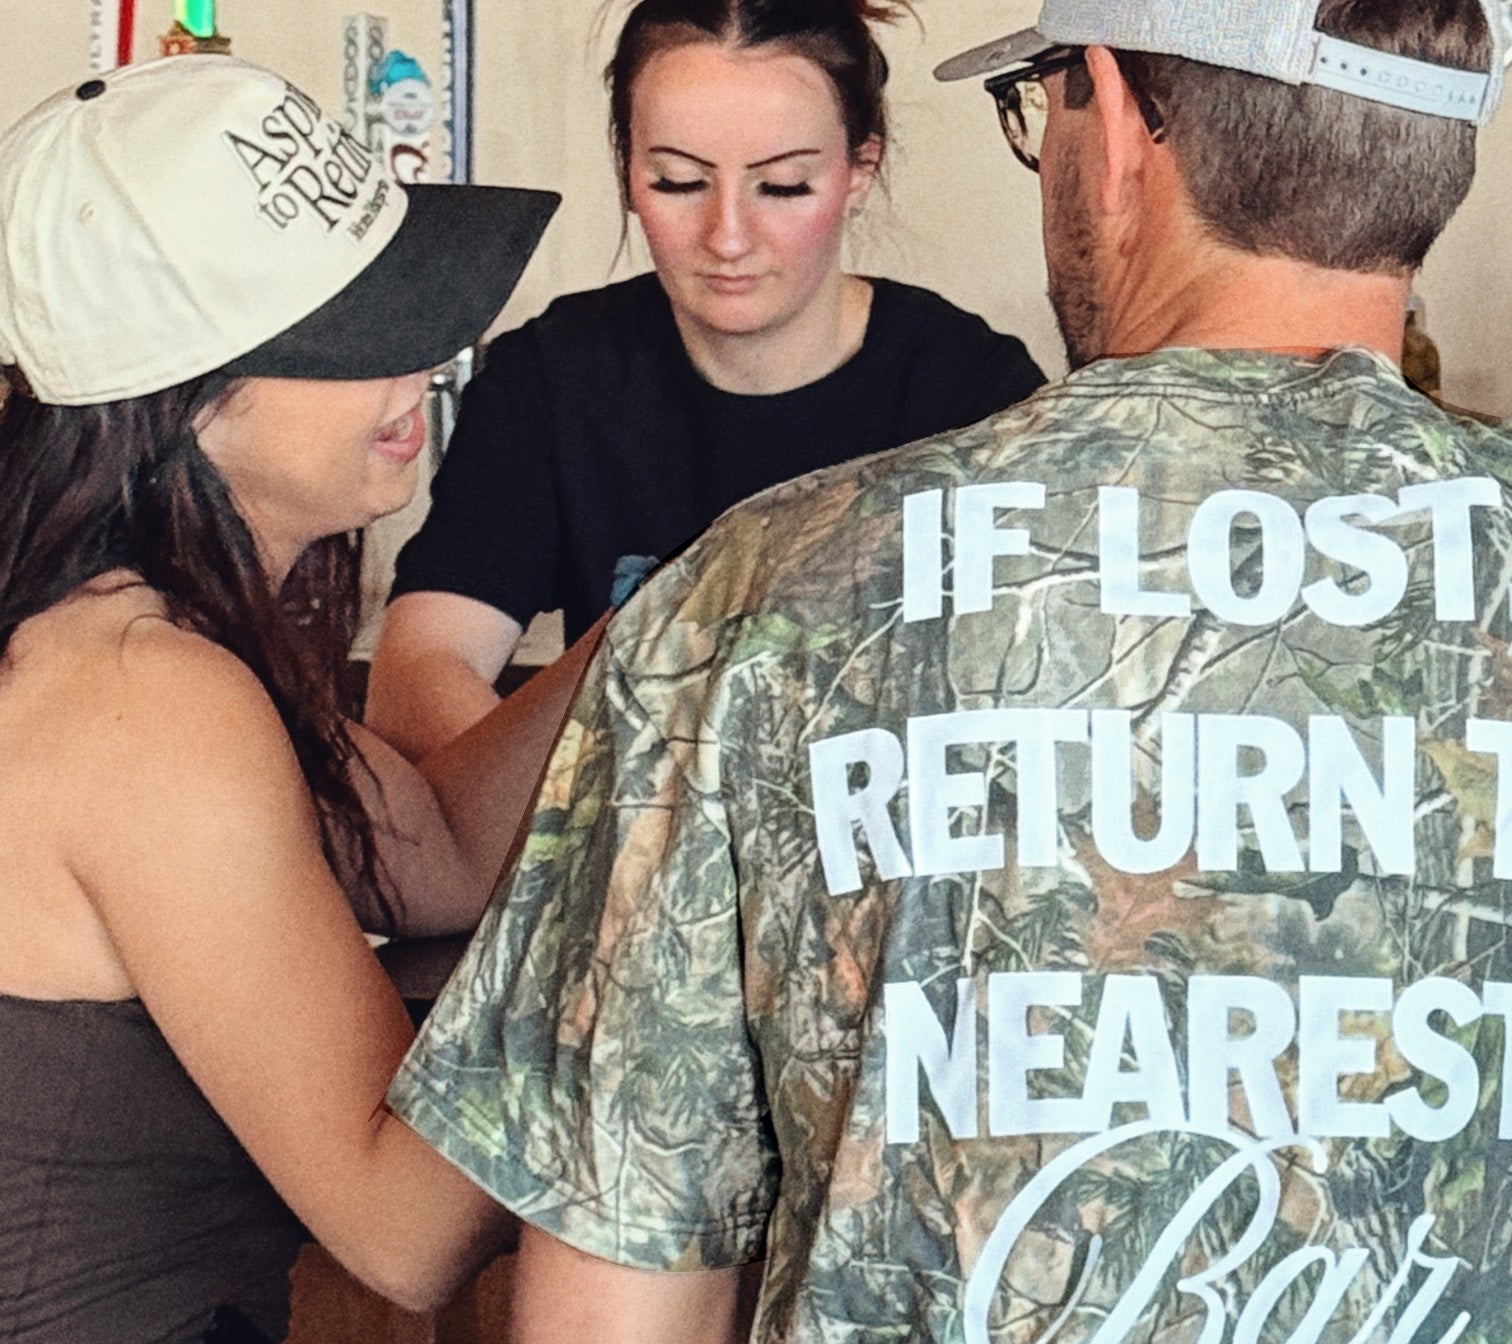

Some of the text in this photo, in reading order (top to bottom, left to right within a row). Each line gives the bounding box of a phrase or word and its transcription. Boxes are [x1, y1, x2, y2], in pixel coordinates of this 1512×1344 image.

[259, 193, 300, 230] to
[902, 480, 1046, 623] IF
[808, 708, 1416, 897] RETURN
